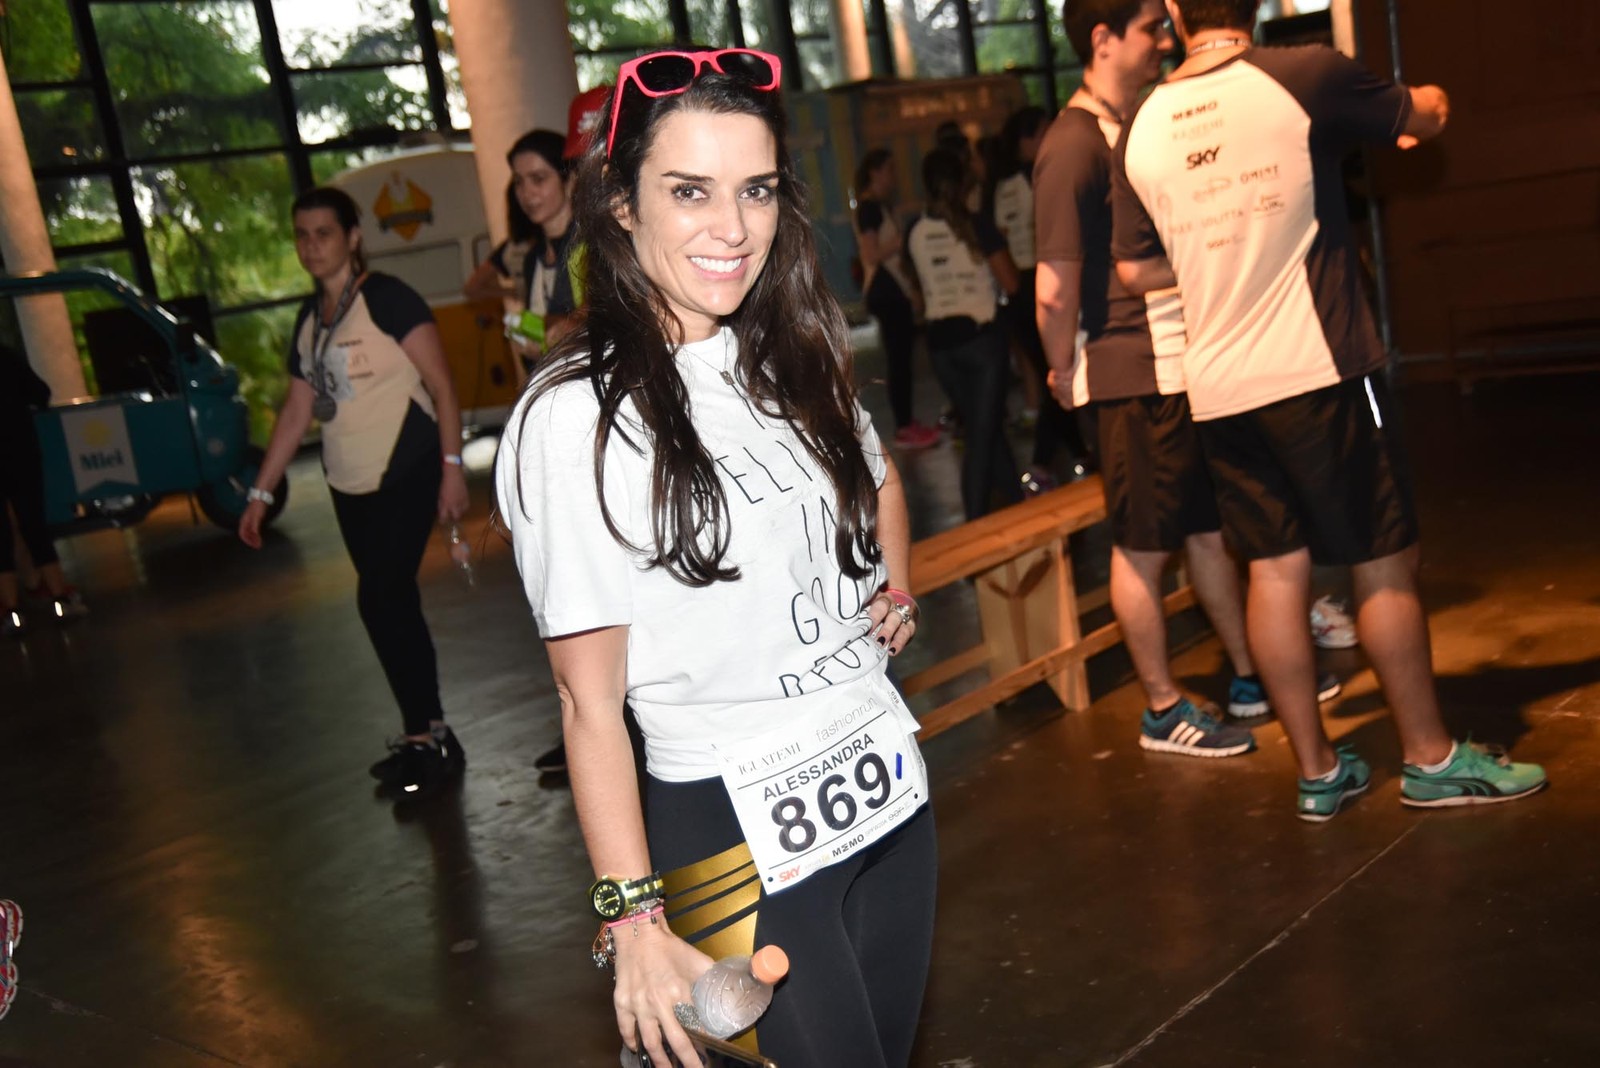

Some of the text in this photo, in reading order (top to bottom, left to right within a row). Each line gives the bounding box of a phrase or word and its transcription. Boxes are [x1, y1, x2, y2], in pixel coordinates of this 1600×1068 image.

[1186, 145, 1222, 170] SKY
[738, 697, 878, 775] IGUATEMI fashionrun
[764, 733, 875, 801] ALESSANDRA
[771, 752, 891, 853] 869
[779, 865, 801, 883] SKY
